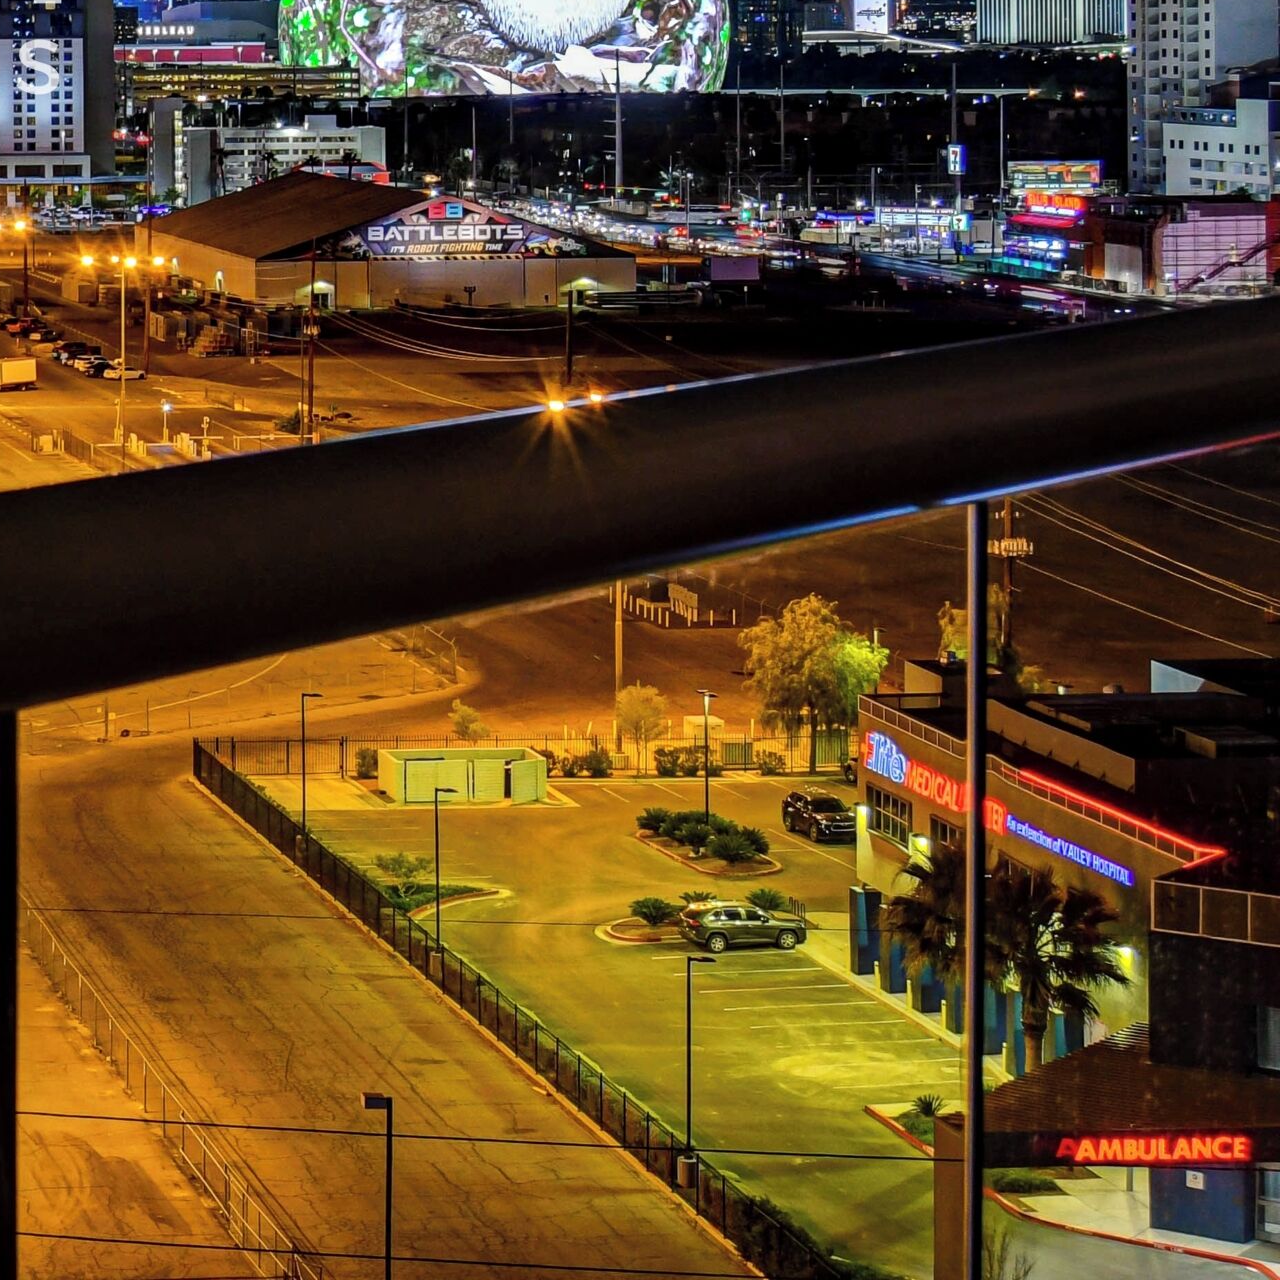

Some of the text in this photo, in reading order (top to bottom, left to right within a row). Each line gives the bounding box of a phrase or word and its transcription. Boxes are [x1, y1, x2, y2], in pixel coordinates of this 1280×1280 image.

[407, 243, 438, 253] ROBOT
[440, 242, 483, 253] FIGHTING
[904, 759, 959, 811] MEDICAL
[1061, 839, 1093, 867] VALLEY
[1092, 854, 1133, 887] HOSPITAL
[1074, 1136, 1250, 1162] AMBULANCE
